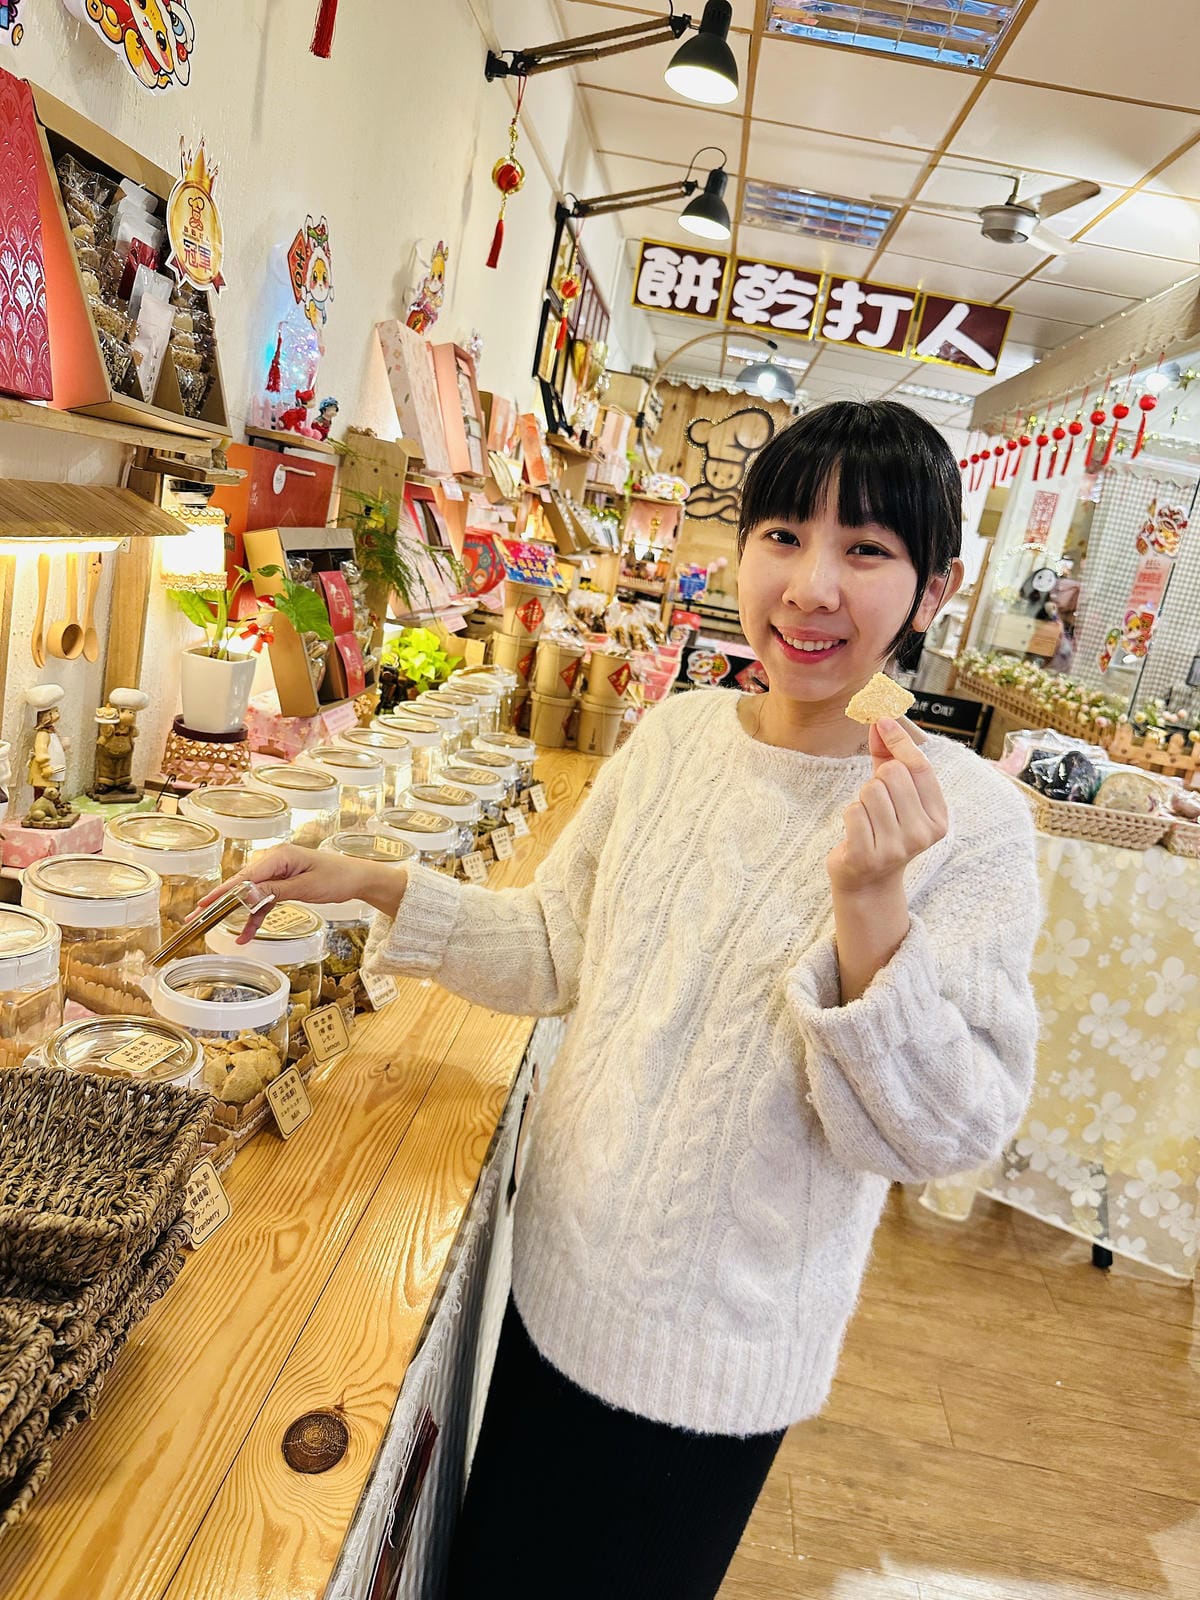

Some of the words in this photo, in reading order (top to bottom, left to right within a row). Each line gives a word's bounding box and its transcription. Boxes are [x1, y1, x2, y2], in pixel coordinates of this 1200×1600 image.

[183, 239, 212, 272] 冠軍
[637, 247, 996, 371] 餅乾打人
[324, 1041, 341, 1053] Lemon
[291, 1109, 301, 1121] Milk
[194, 1208, 221, 1236] Cranberry
